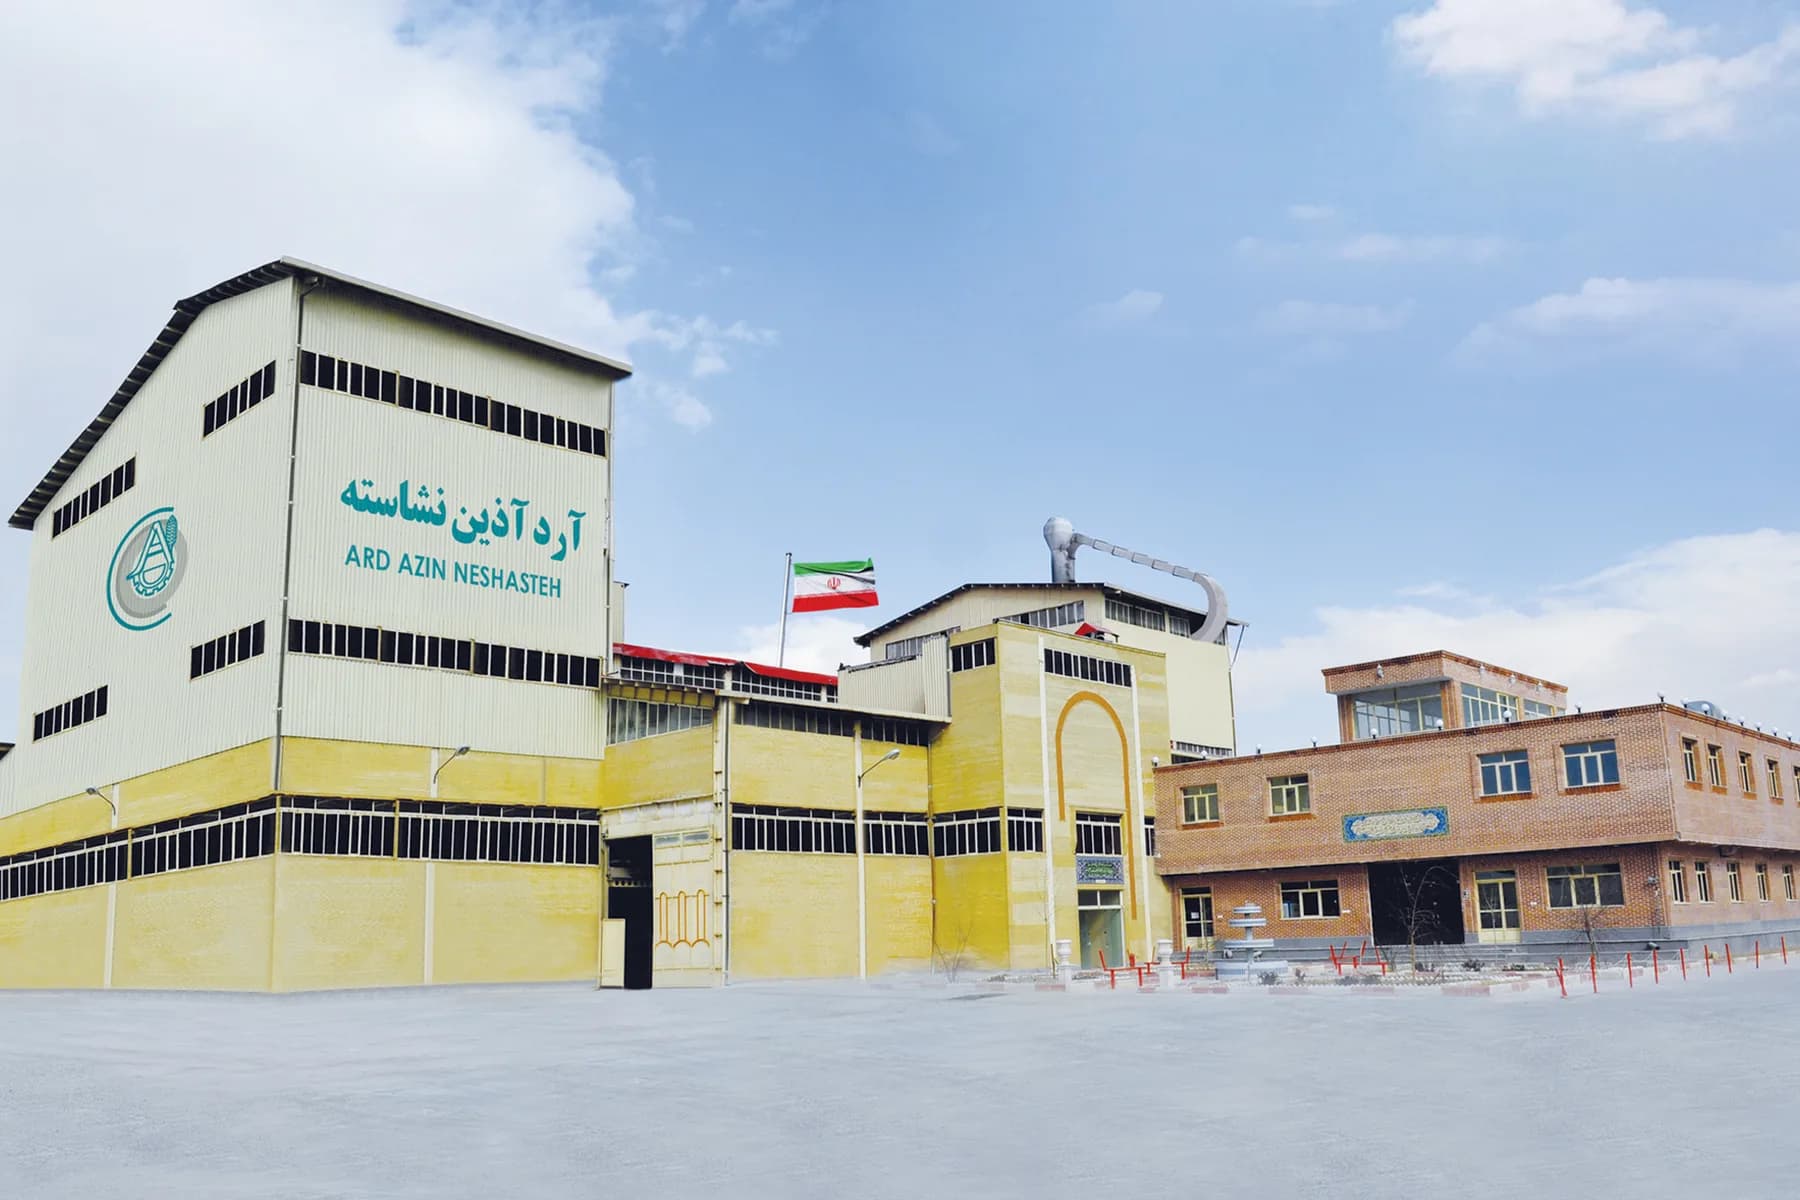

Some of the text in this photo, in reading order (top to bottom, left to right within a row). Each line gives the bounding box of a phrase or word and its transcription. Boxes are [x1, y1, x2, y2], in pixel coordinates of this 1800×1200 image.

[340, 479, 587, 562] آرد آذین نشاسته
[344, 544, 561, 598] ARD AZIN NESHASTEH
